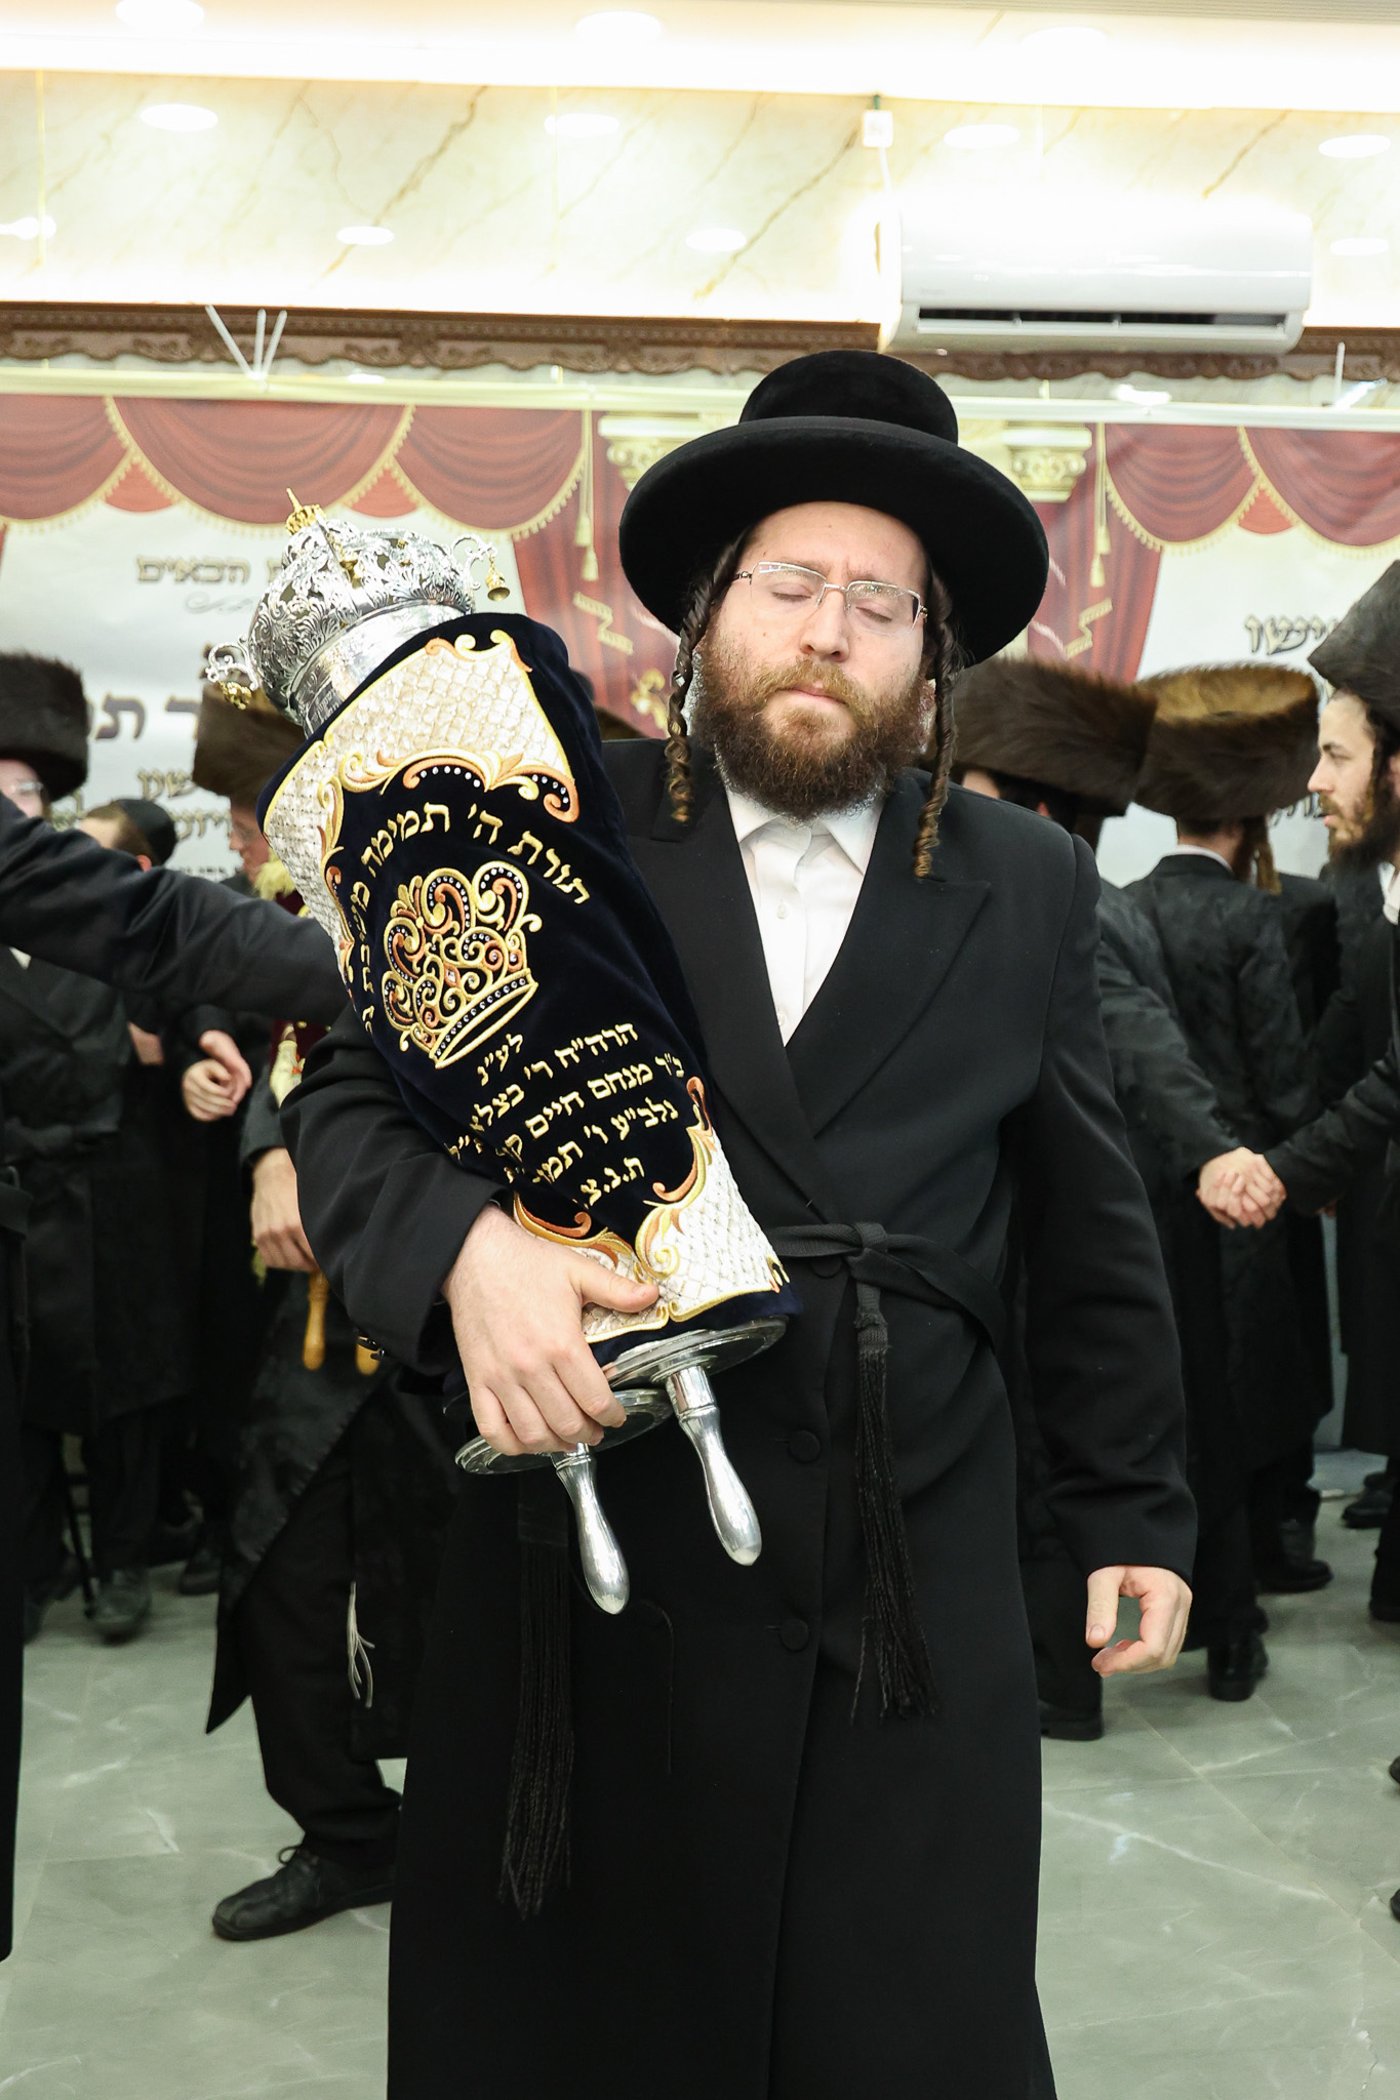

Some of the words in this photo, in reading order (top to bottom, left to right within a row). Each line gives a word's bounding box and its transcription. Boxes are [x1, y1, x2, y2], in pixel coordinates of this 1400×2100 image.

[136, 556, 249, 584] הבאים
[361, 802, 450, 877] תמימה
[467, 803, 503, 844] ה'
[507, 831, 590, 904] תורת
[477, 1033, 523, 1087] לע"נ
[554, 1023, 638, 1068] הרה"ח
[524, 1061, 553, 1080] ר'
[587, 1064, 653, 1099] מנחם
[525, 1091, 584, 1138] חיים
[611, 1097, 678, 1140] נלב"ע
